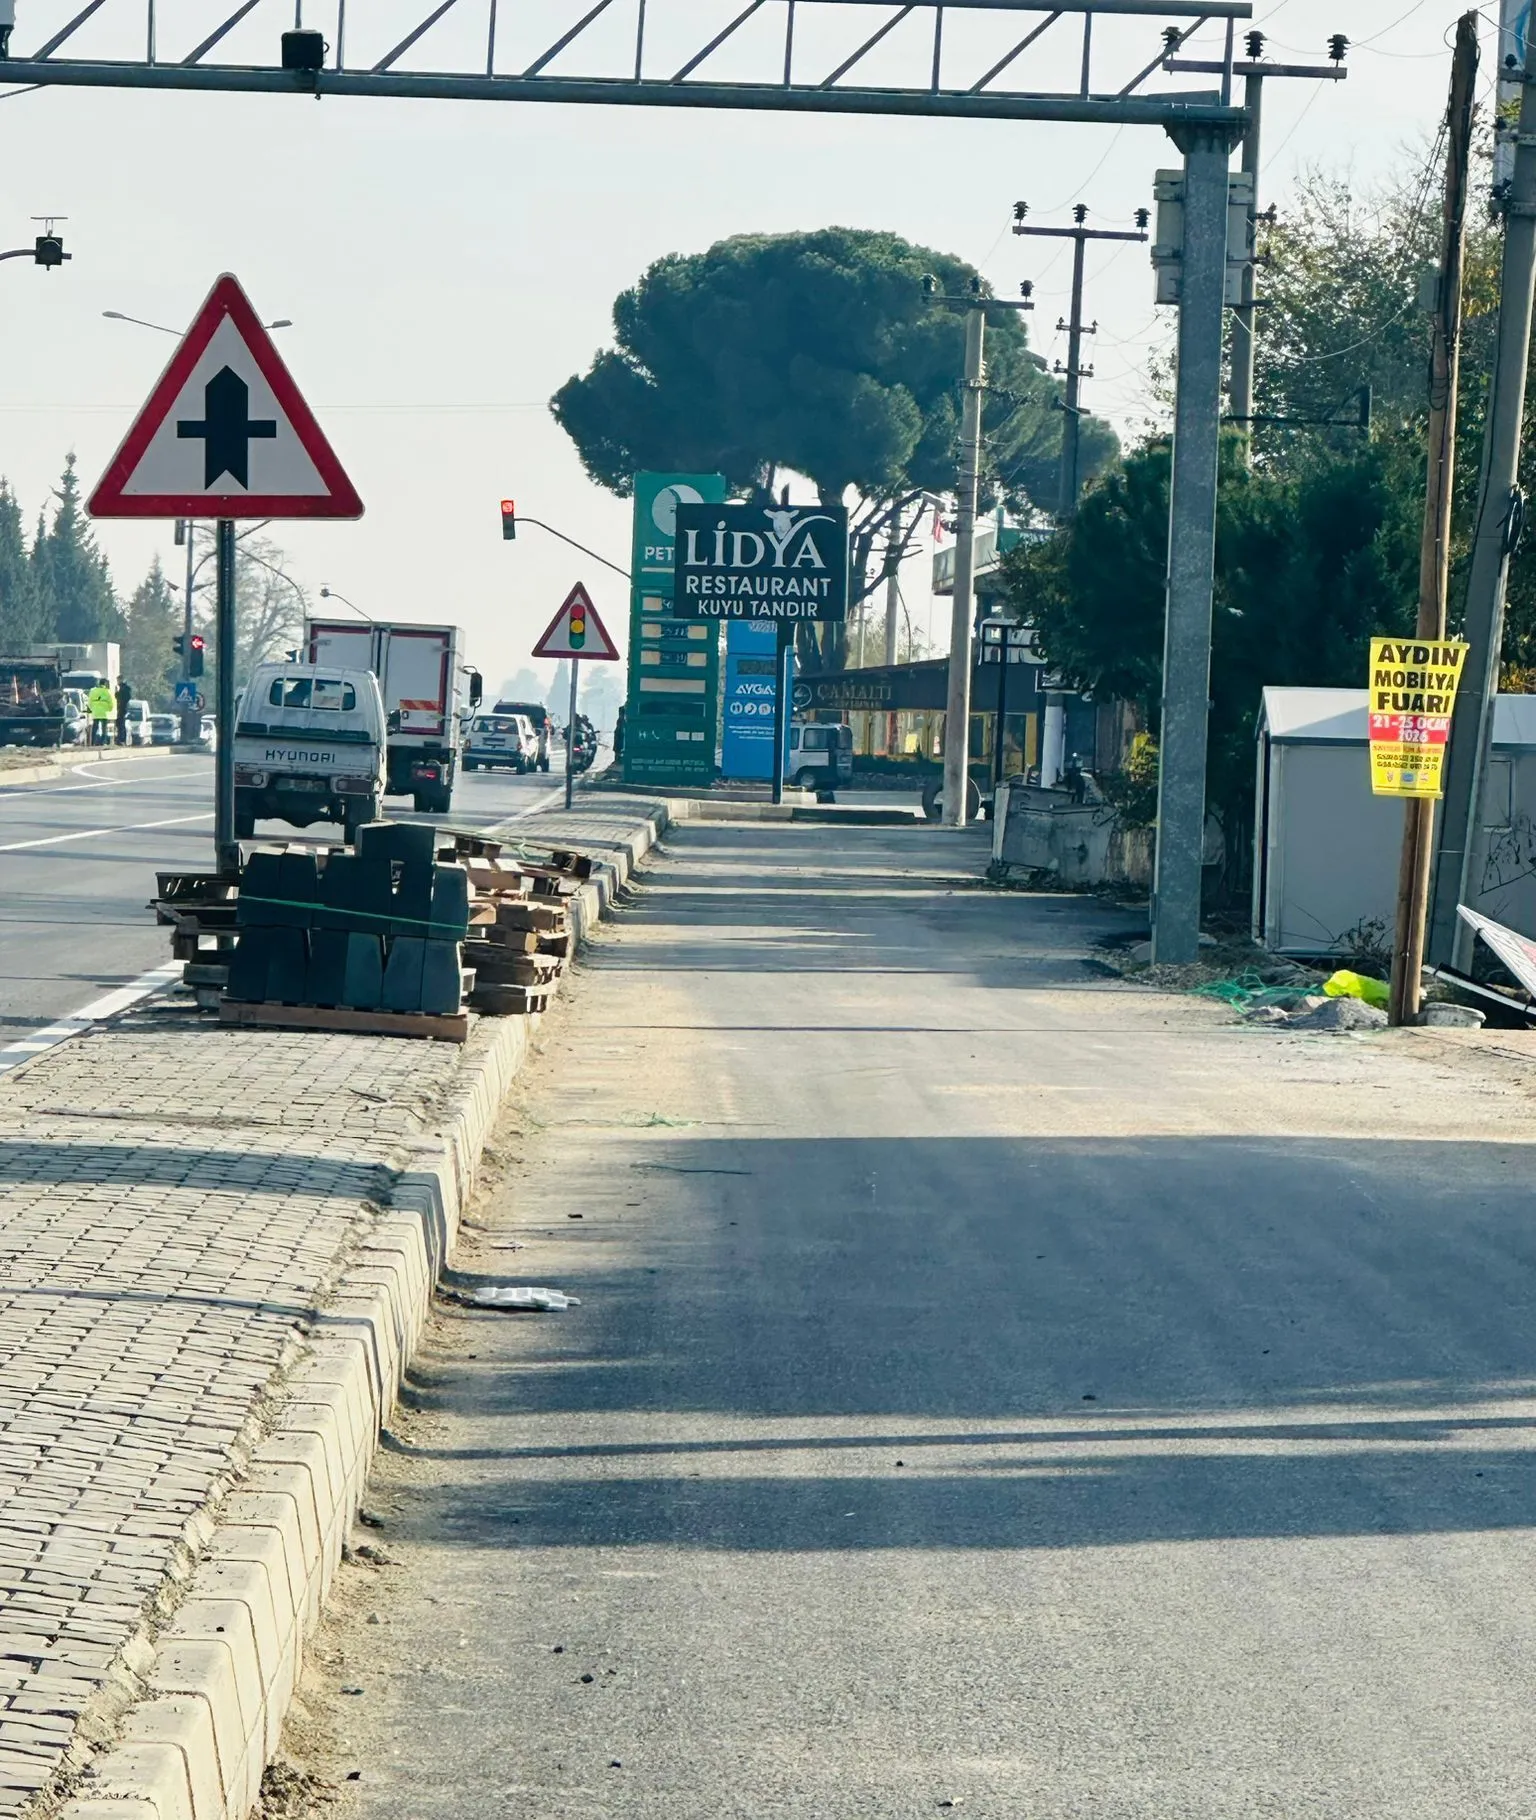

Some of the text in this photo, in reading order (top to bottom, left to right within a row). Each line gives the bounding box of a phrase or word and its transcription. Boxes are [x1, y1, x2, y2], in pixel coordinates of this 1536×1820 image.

[684, 516, 836, 569] LİDYA
[686, 575, 832, 597] RESTAURANT
[698, 600, 818, 617] KUYU TANDIR
[1378, 644, 1460, 667] AYDIN
[1374, 667, 1455, 691] MOBİLYA
[1378, 692, 1450, 713] FUARI
[1373, 715, 1414, 729] 21-25
[1398, 729, 1429, 742] 2026
[265, 750, 335, 763] HYUNDAI
